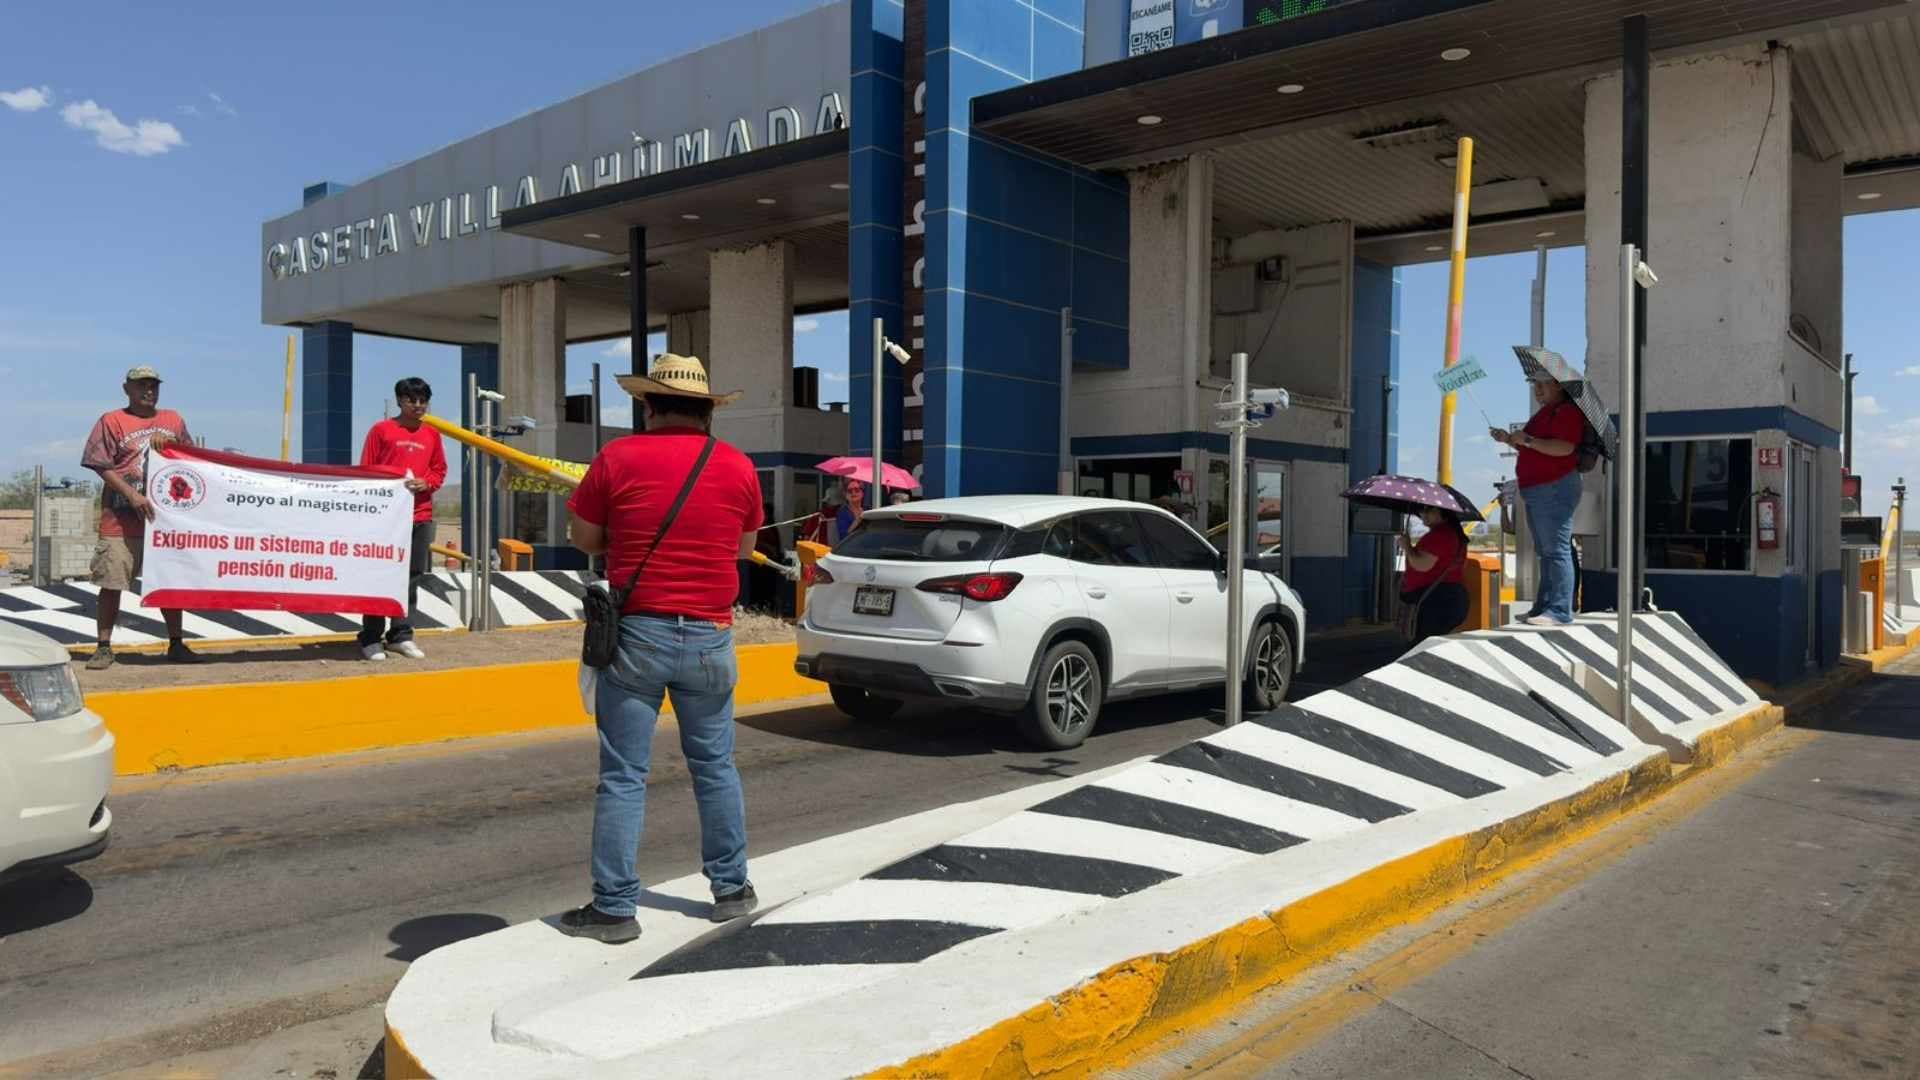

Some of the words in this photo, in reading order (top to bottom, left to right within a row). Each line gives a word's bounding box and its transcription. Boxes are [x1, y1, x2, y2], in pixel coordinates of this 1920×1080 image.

[267, 212, 398, 280] CASETA
[410, 176, 537, 247] VILLA
[558, 92, 846, 197] AHUMADA
[226, 491, 275, 508] apoyo
[279, 493, 294, 507] al
[153, 530, 229, 551] Exigimos
[234, 536, 255, 551] un
[260, 536, 324, 556] sistema
[329, 539, 348, 557] de
[353, 542, 394, 560] salud
[398, 547, 405, 563] y
[217, 559, 284, 578] pensión
[290, 562, 338, 581] digna.
